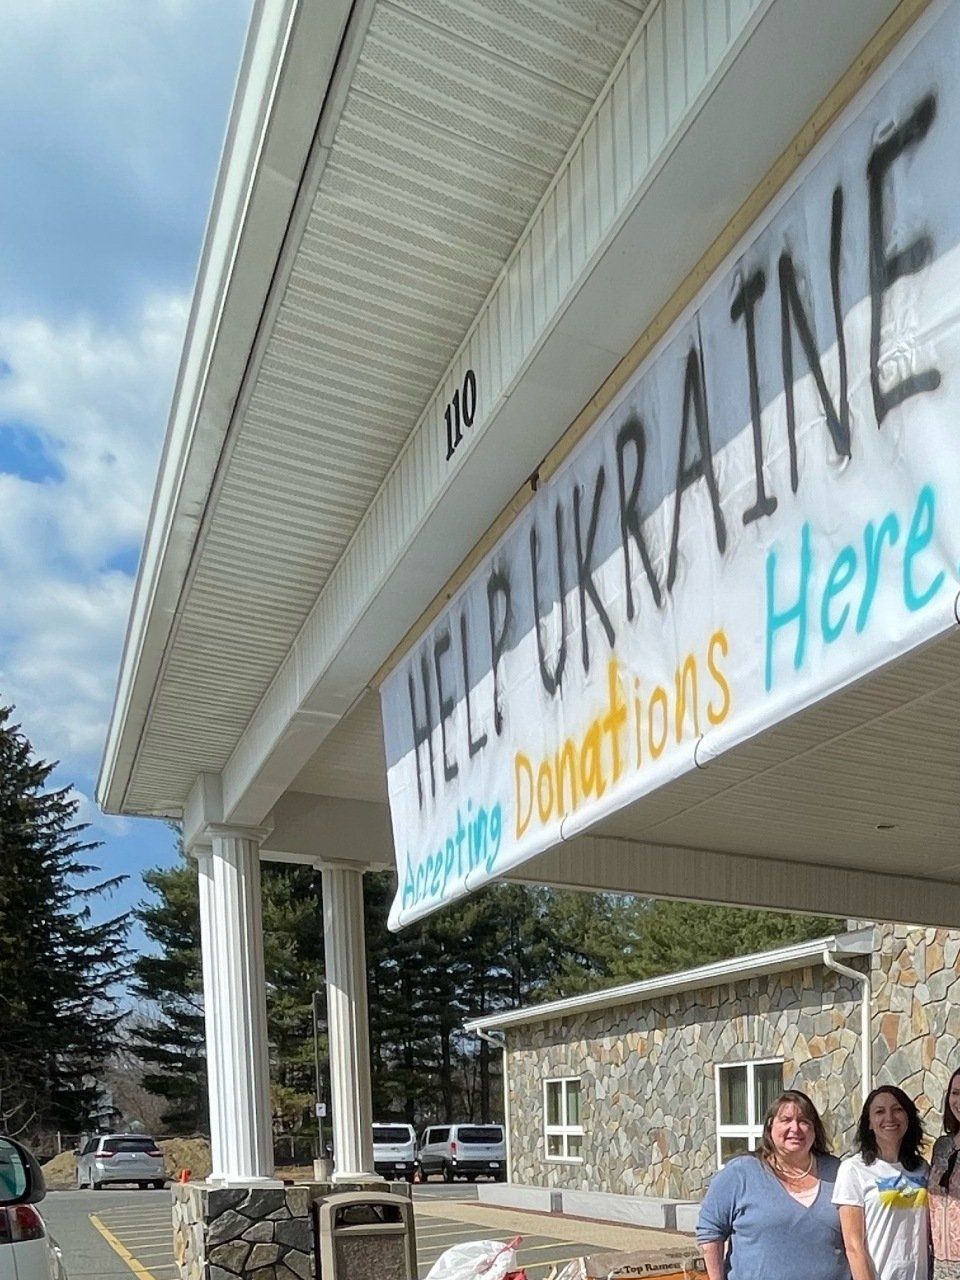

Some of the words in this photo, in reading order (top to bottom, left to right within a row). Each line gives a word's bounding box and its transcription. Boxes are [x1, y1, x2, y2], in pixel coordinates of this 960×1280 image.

[405, 560, 515, 812] HELP
[528, 92, 941, 694] UKRAINE
[444, 369, 477, 461] 110
[402, 797, 502, 909] Accepting
[513, 630, 732, 840] Donations
[624, 1265, 643, 1275] Top
[644, 1261, 681, 1272] Ramen
